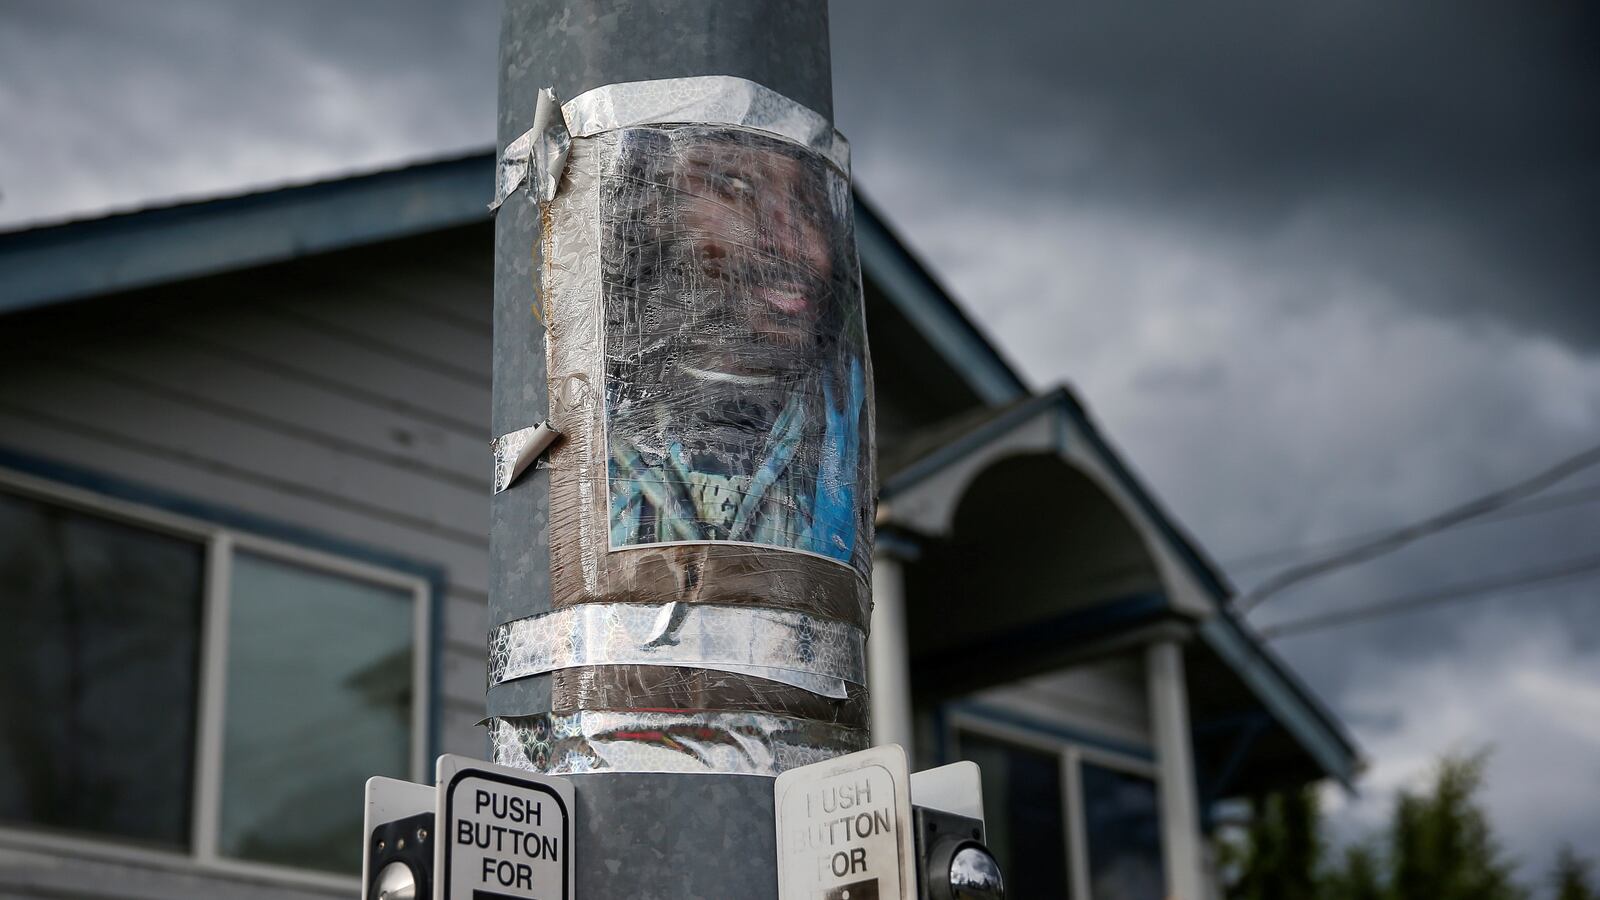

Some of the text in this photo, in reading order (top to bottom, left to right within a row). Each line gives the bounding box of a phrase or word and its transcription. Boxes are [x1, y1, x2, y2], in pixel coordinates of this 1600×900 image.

[475, 789, 542, 827] PUSH
[456, 818, 558, 862] BUTTON
[793, 808, 891, 855] UTTON
[482, 857, 533, 891] FOR
